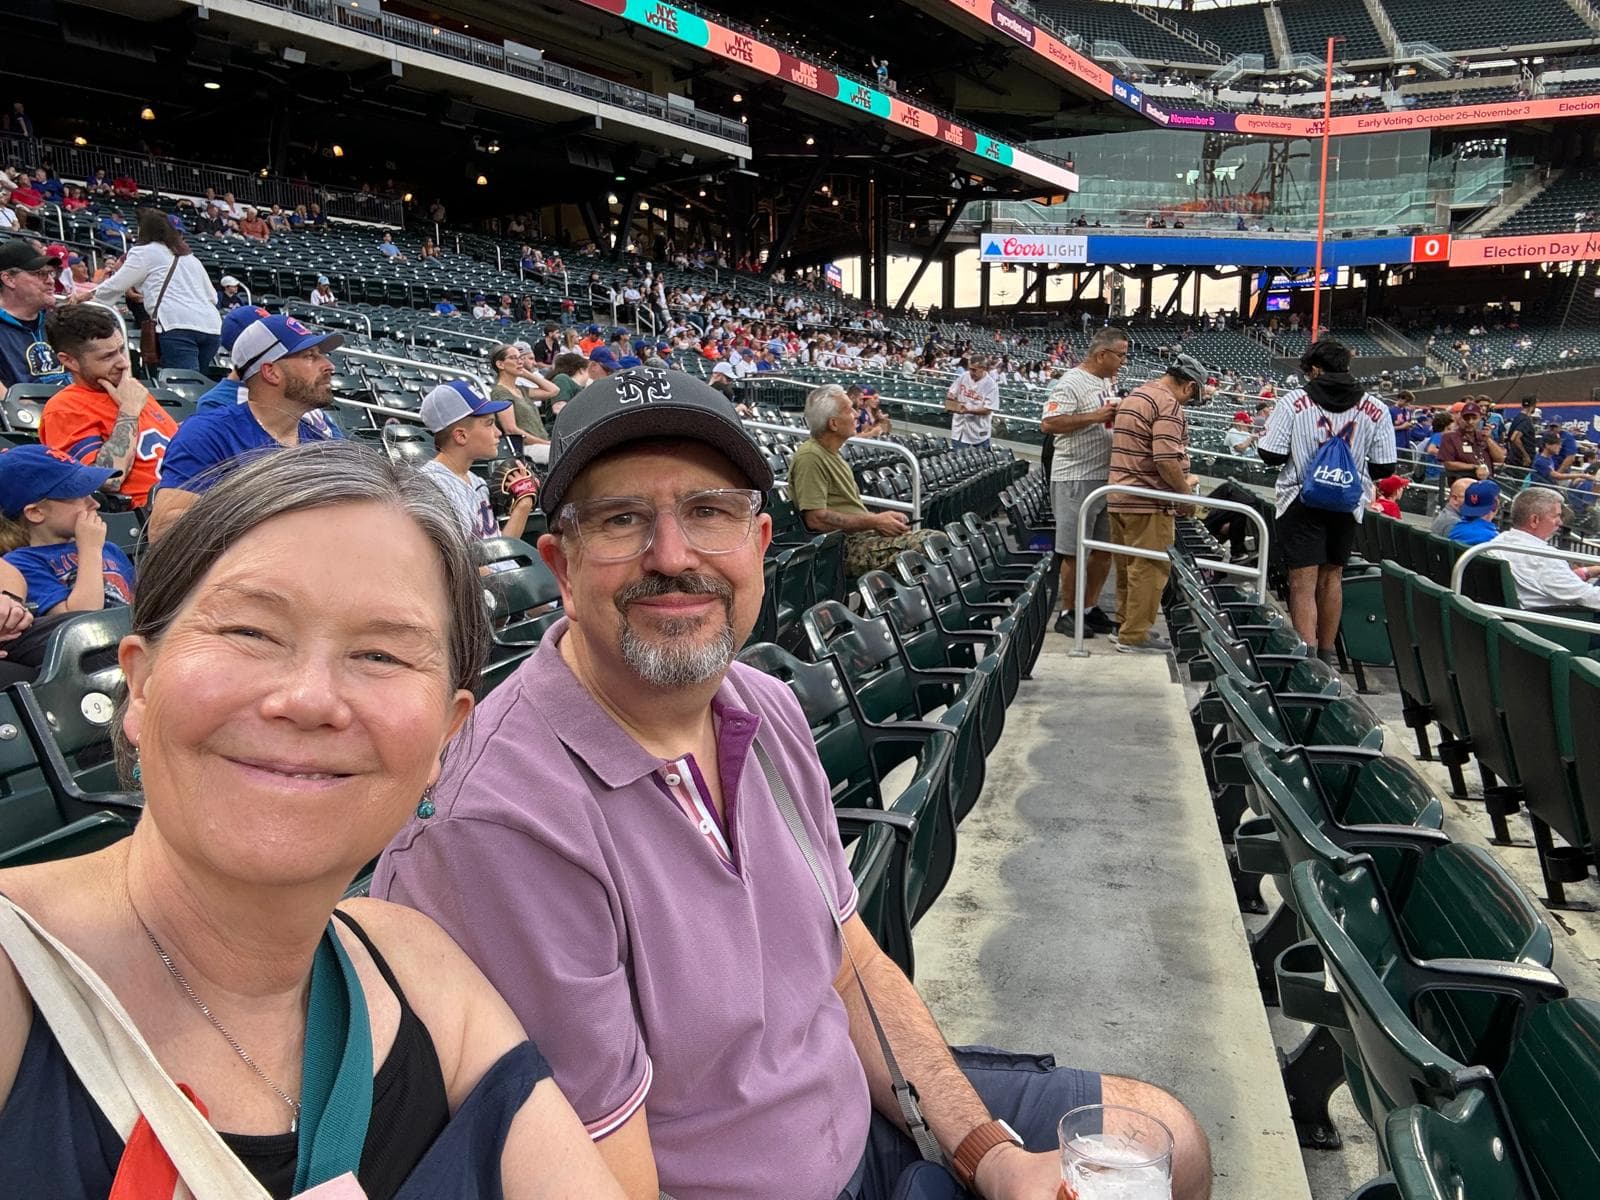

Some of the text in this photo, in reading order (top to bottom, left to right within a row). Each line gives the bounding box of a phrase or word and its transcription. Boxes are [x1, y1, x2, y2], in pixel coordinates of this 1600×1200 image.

[656, 3, 678, 20] NYC
[645, 9, 679, 34] VOTES
[724, 41, 754, 63] VOTES
[734, 35, 753, 52] NYC
[799, 61, 818, 78] NYC
[791, 69, 818, 89] VOTES
[849, 92, 872, 110] VOTES
[857, 86, 872, 99] NYC
[907, 107, 920, 120] NYC
[1559, 101, 1600, 112] Election
[901, 113, 920, 128] VOTES
[1170, 114, 1208, 125] November
[1209, 116, 1215, 126] 5
[1248, 119, 1292, 131] nycvotes.org
[1312, 120, 1329, 128] NY
[1357, 118, 1381, 129] Early
[1384, 116, 1413, 127] Voting
[1416, 112, 1454, 123] October
[1523, 106, 1531, 115] 3
[1002, 237, 1085, 257] Coors LIGHT
[1424, 239, 1440, 257] 0
[1483, 245, 1546, 258] Election
[1550, 242, 1579, 256] Day
[93, 702, 102, 714] 9
